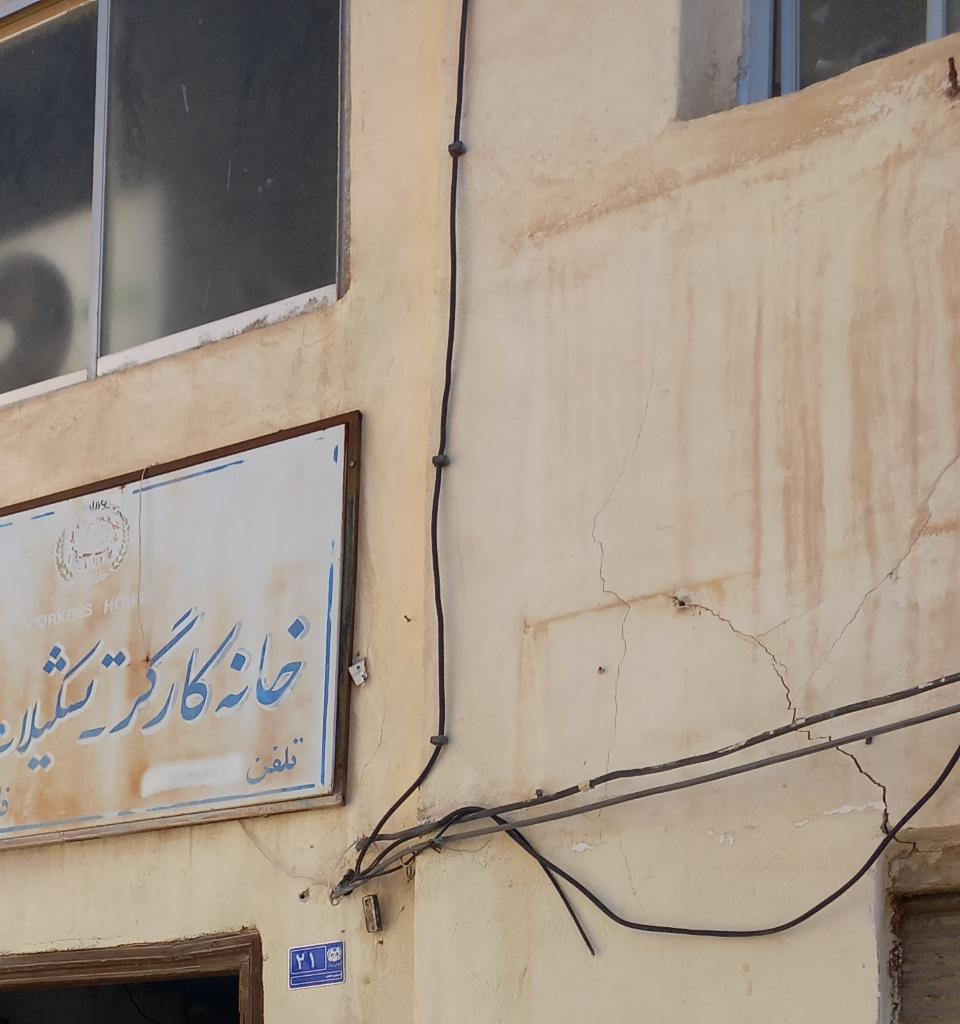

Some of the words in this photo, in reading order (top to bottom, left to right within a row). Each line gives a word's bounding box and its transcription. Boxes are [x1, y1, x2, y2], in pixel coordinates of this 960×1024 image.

[27, 602, 93, 629] ORKERS
[109, 607, 238, 734] کارگر
[215, 617, 306, 713] خانه
[246, 737, 304, 785] تلفن
[295, 951, 315, 970] ۲۱
